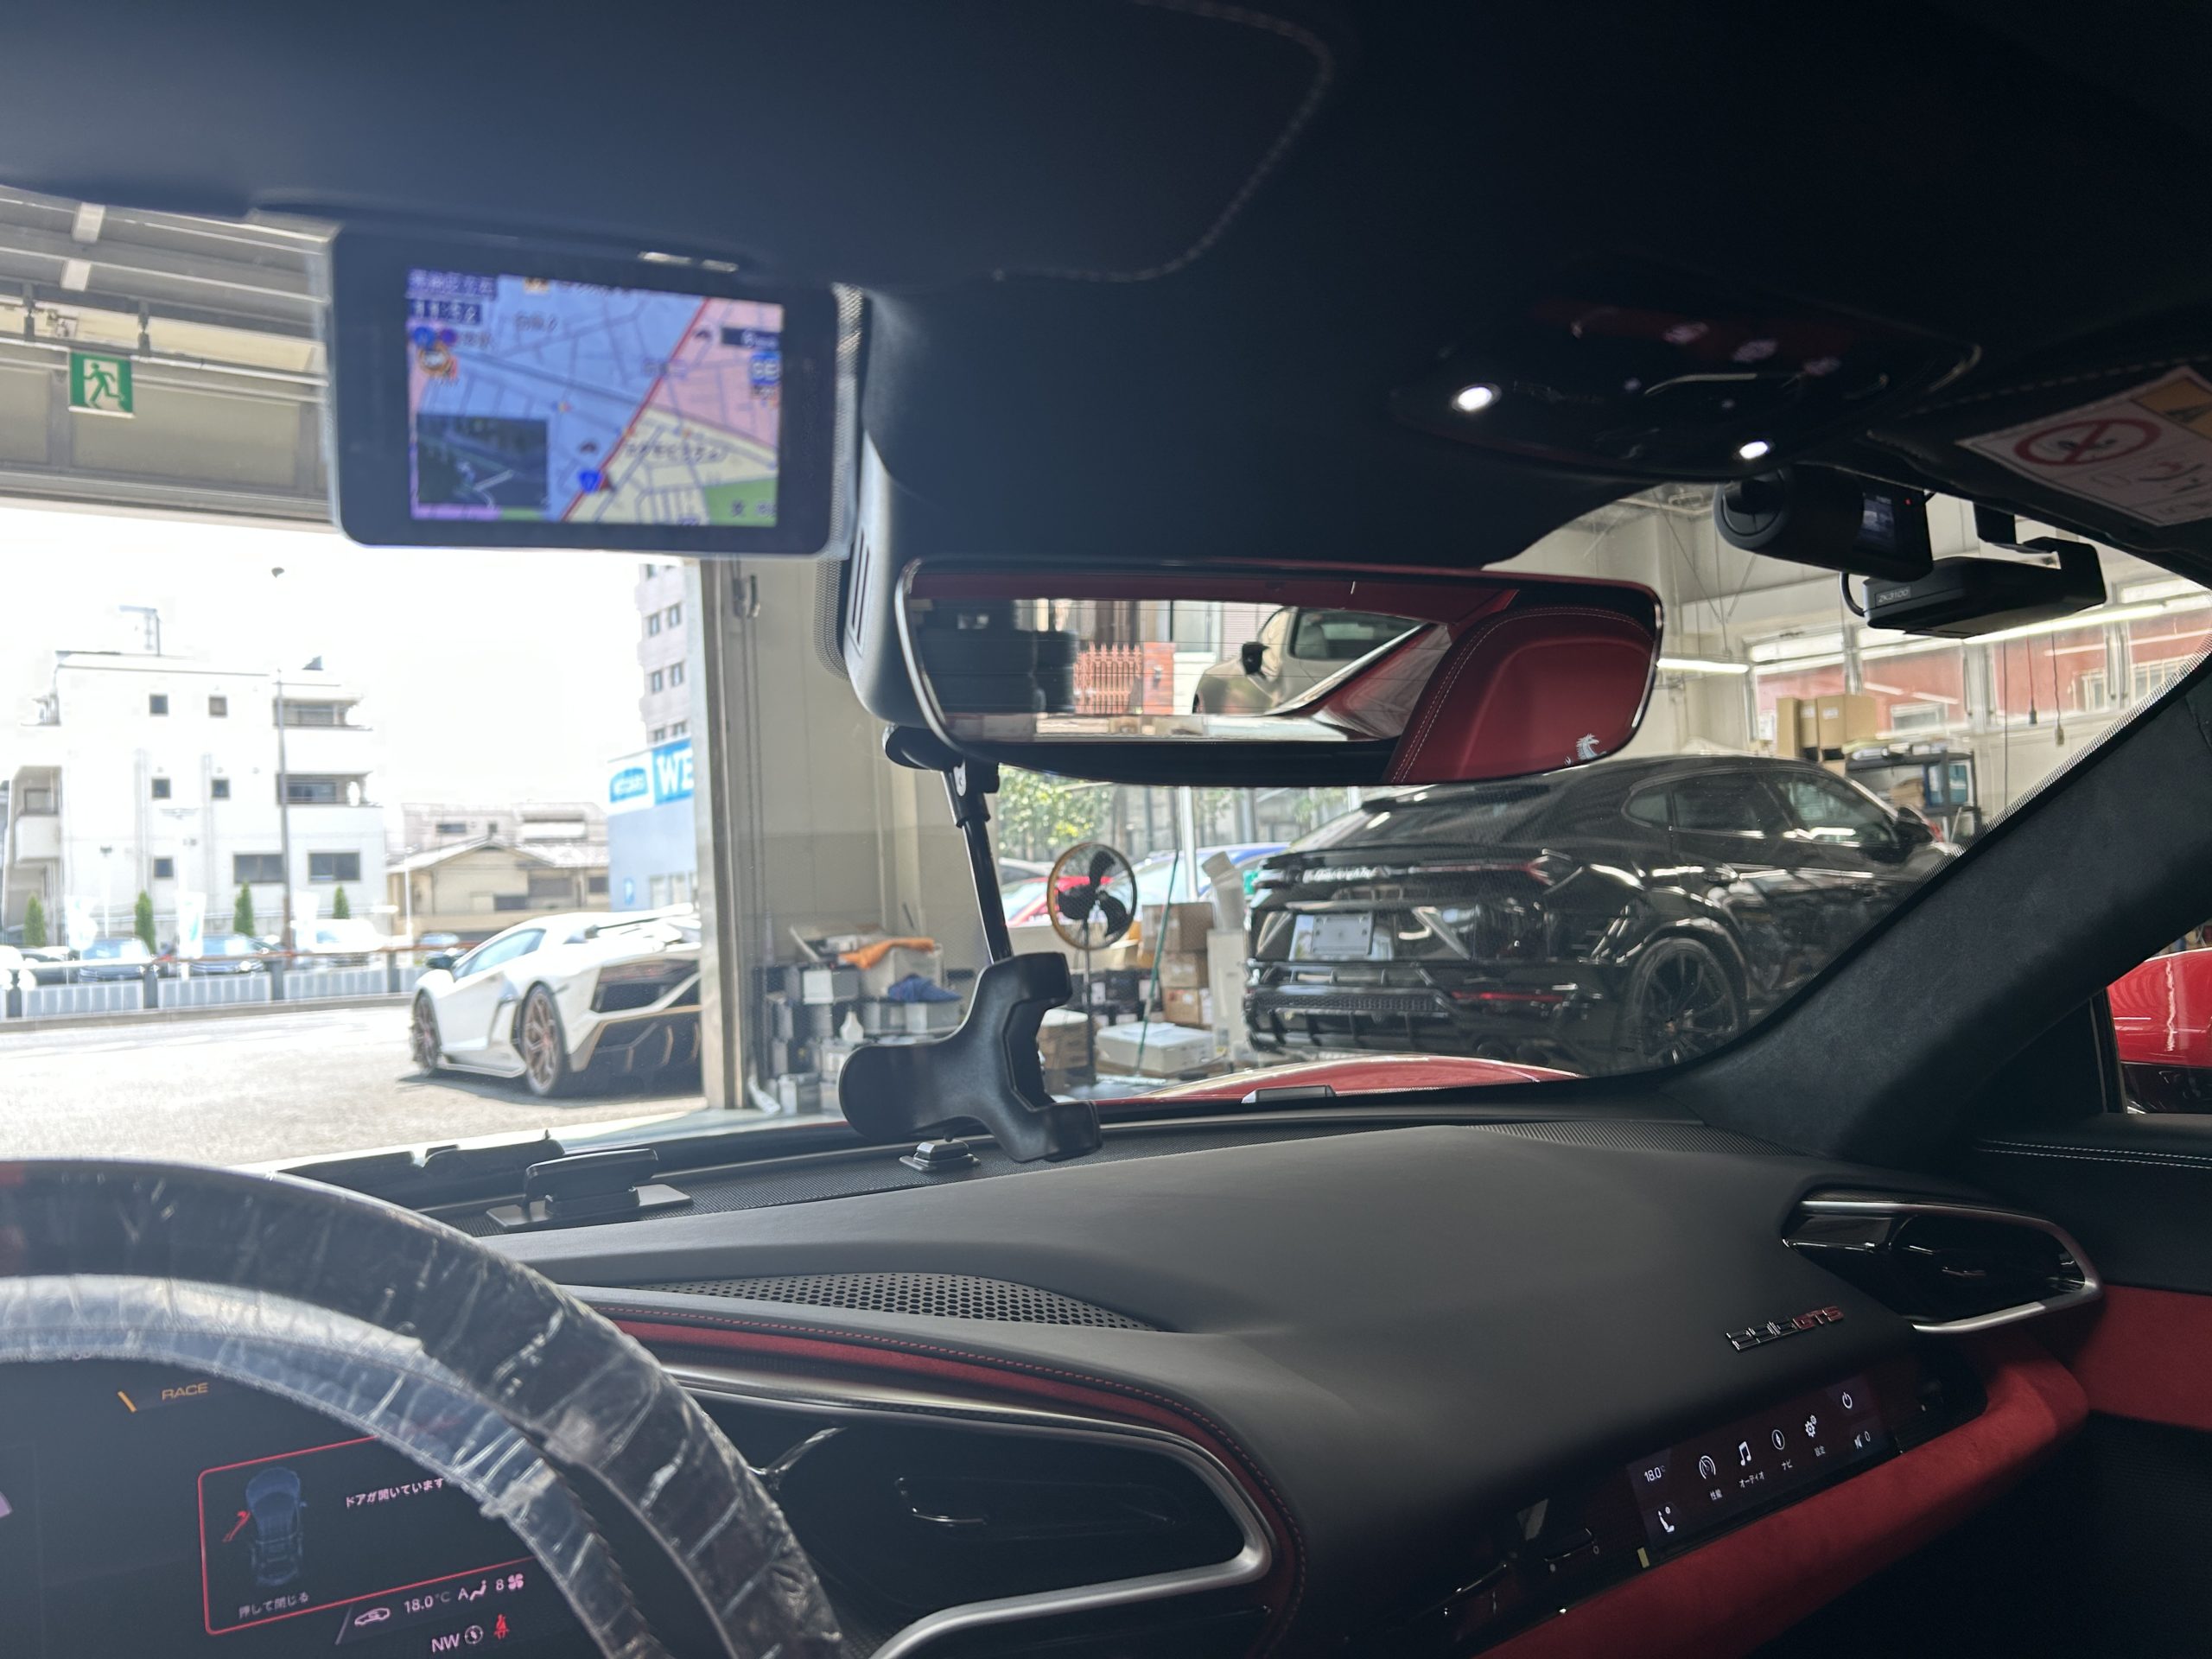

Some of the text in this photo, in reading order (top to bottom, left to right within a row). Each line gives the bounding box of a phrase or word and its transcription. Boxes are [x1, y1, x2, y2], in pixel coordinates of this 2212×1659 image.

[162, 1382, 208, 1400] RACE
[1782, 1459, 1793, 1471] ナビ
[346, 1478, 444, 1509] ドアが開いています
[496, 1579, 505, 1591] 8
[431, 1633, 460, 1653] NW
